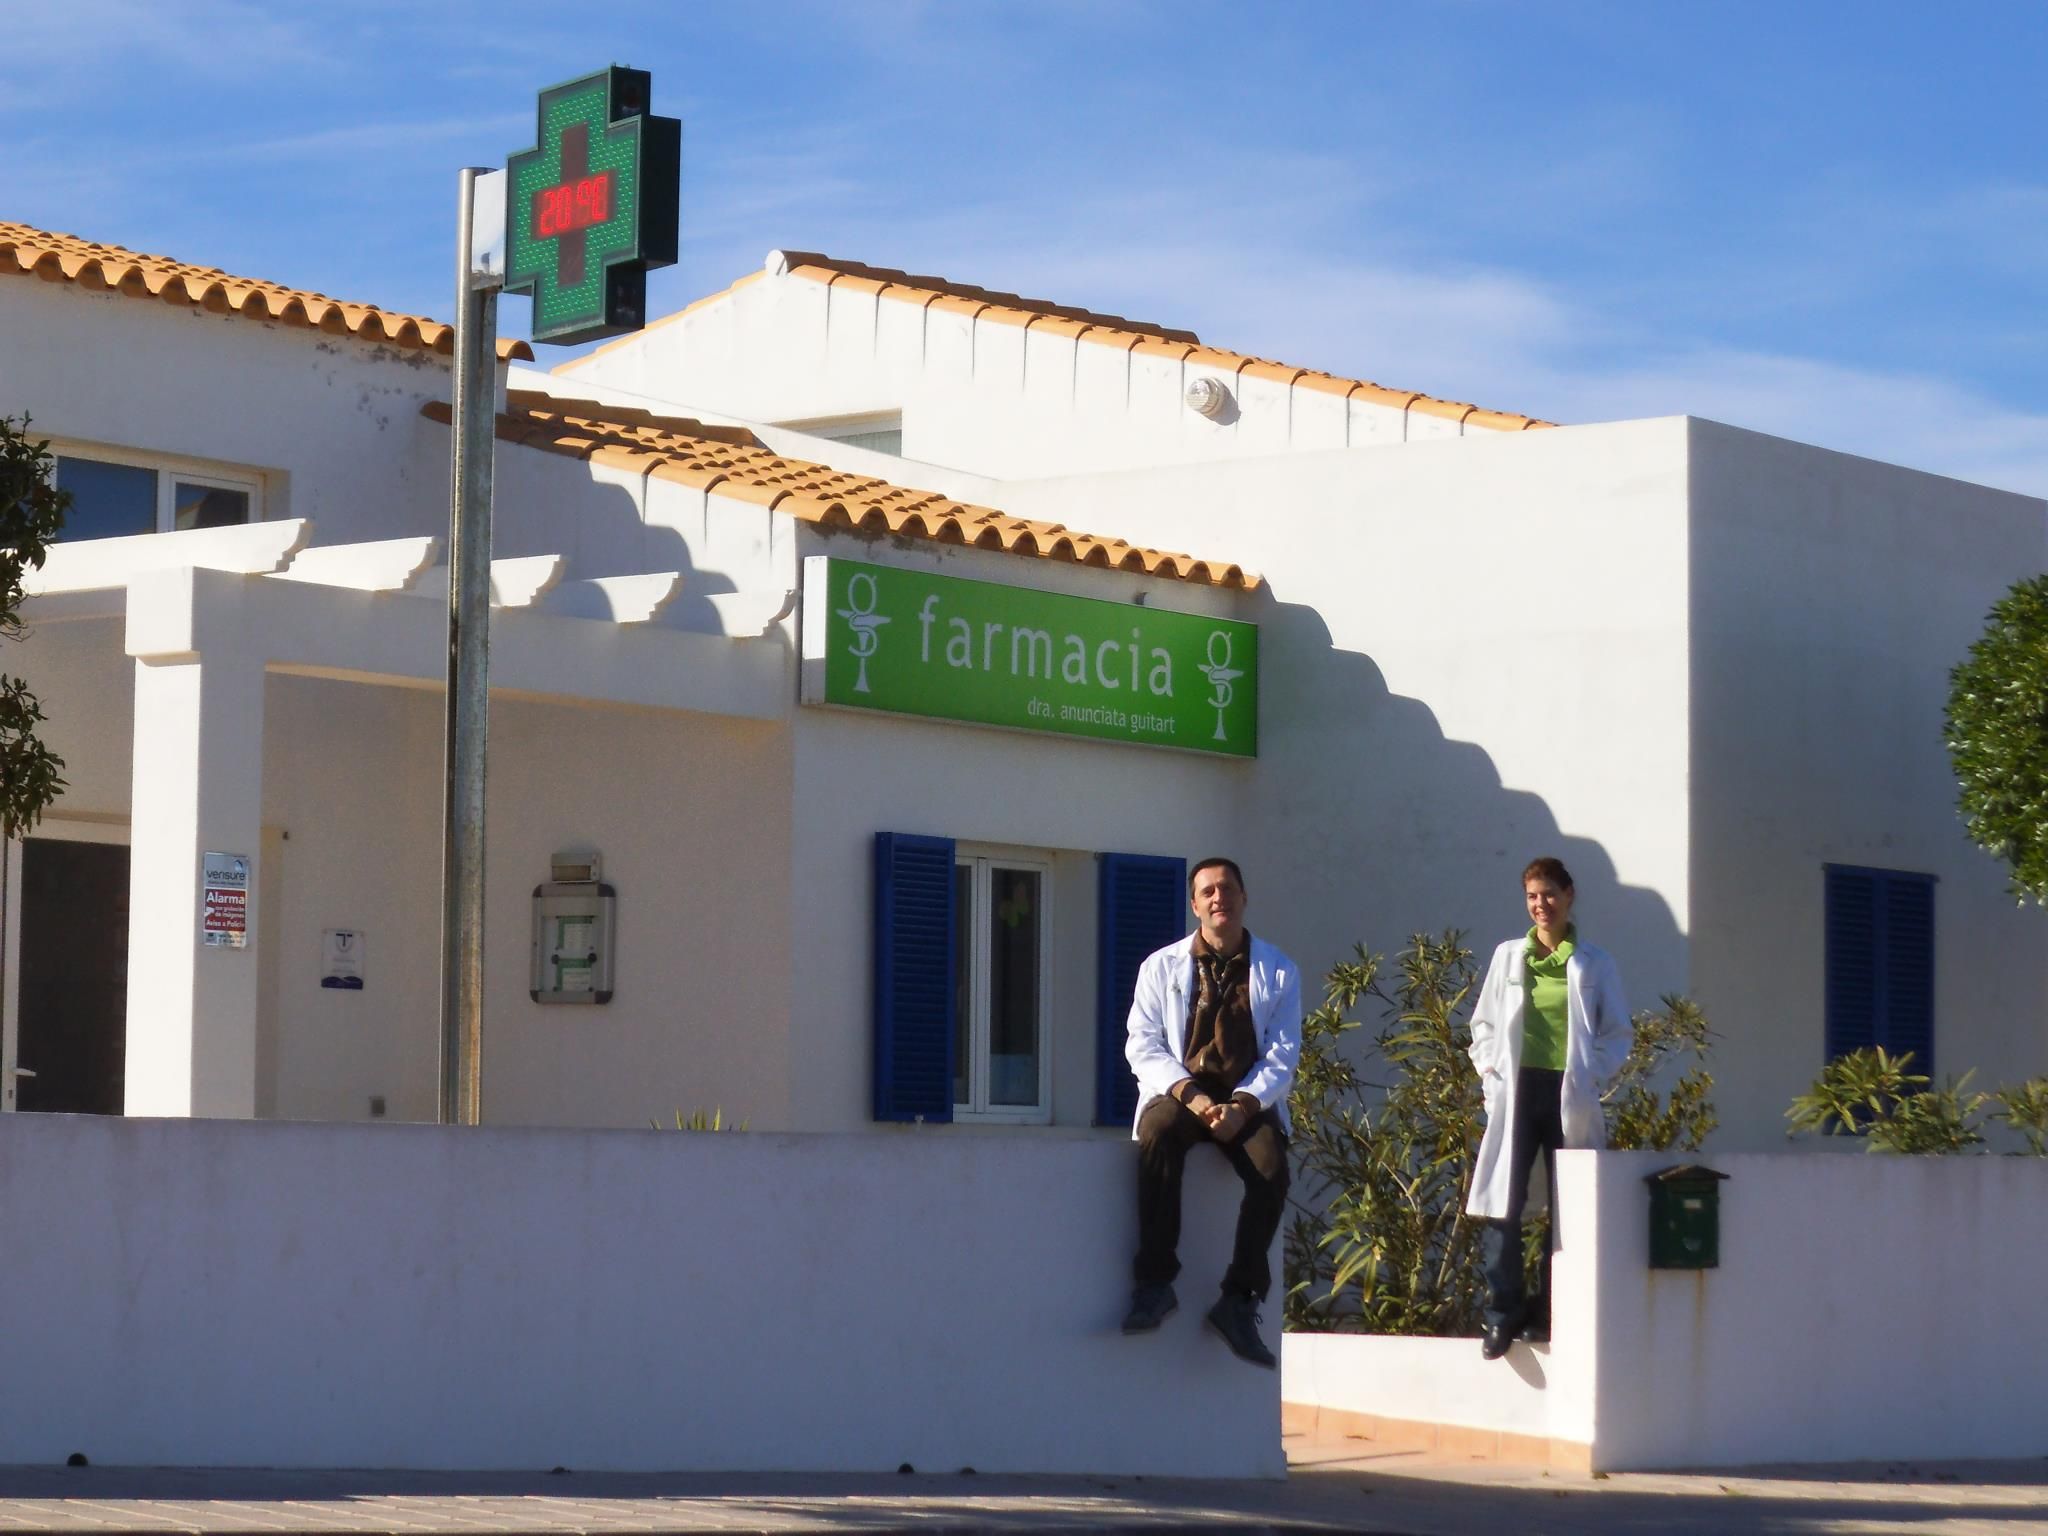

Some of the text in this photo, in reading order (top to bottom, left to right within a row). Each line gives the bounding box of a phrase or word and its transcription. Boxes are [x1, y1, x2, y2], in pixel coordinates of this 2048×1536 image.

[918, 594, 1174, 697] farmacia
[1027, 697, 1175, 734] dra. anunciata guitart
[206, 869, 246, 881] verisure
[206, 891, 245, 905] Alarma
